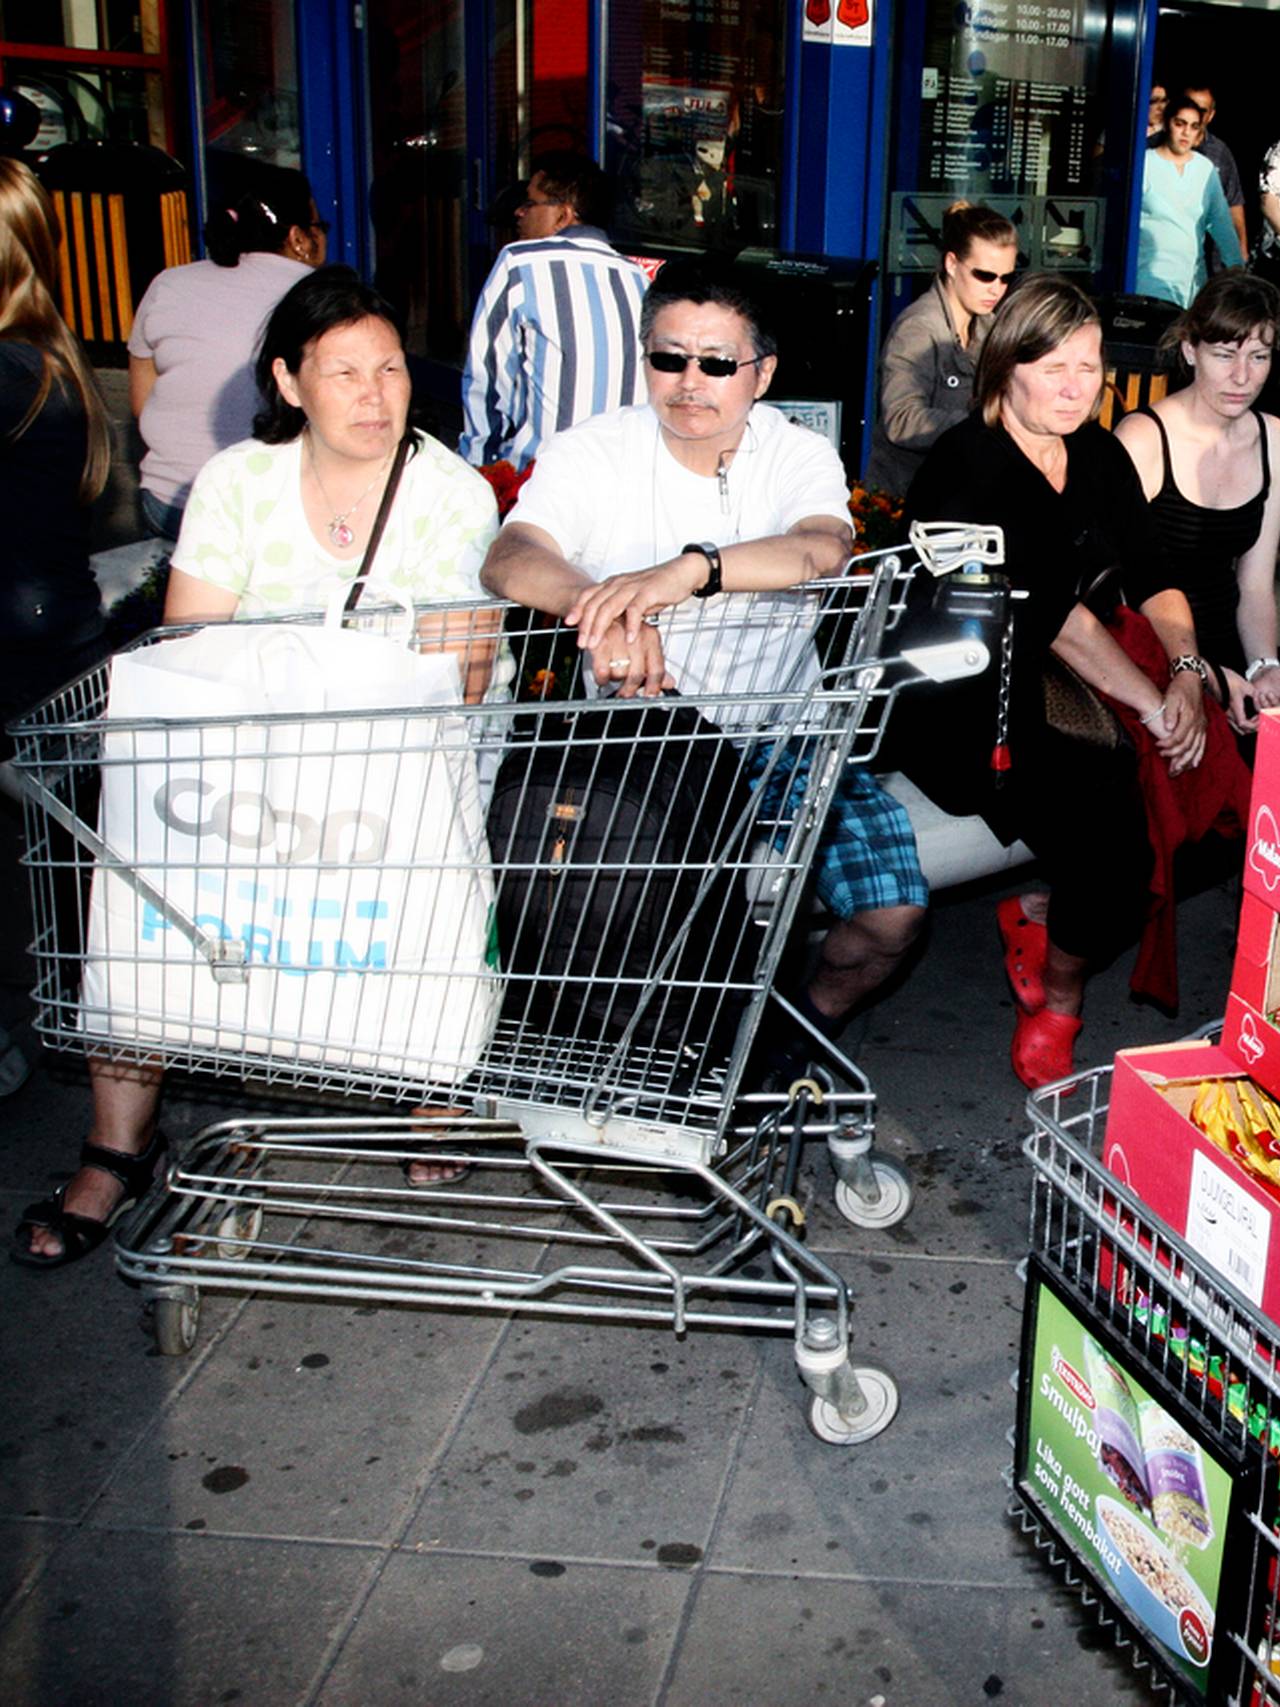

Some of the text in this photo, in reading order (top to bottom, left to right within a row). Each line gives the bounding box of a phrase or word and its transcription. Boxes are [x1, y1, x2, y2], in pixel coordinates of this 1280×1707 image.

[1040, 1372, 1103, 1459] Smulpaj
[1036, 1438, 1091, 1511] Lika gott
[1034, 1463, 1123, 1576] som hembakat
